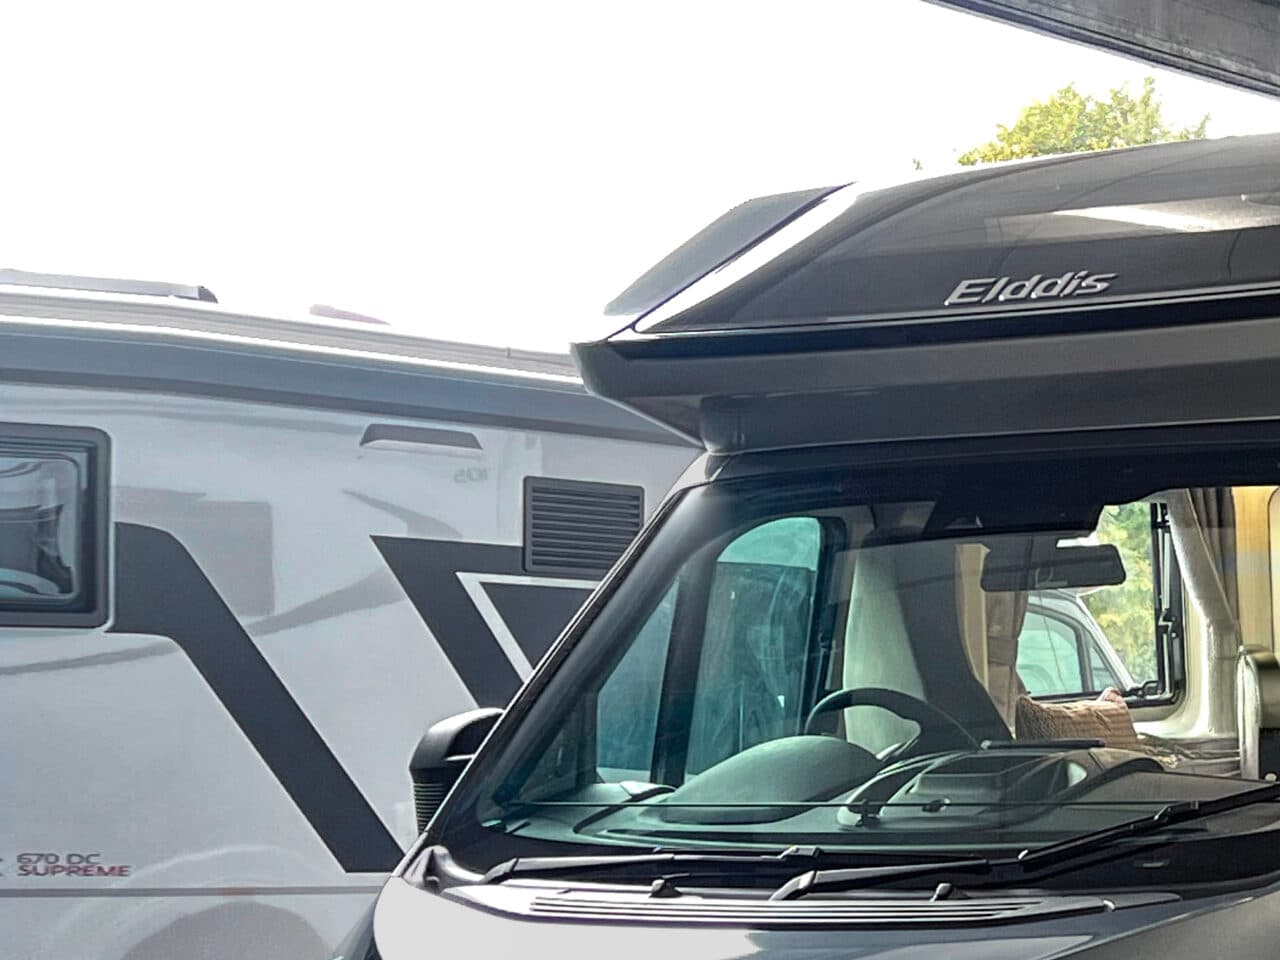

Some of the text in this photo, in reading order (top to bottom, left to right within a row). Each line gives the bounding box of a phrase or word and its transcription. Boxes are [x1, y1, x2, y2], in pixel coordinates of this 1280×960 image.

[944, 270, 1119, 306] Elddis
[17, 852, 101, 865] 670 DC
[18, 864, 131, 877] SUPREME
